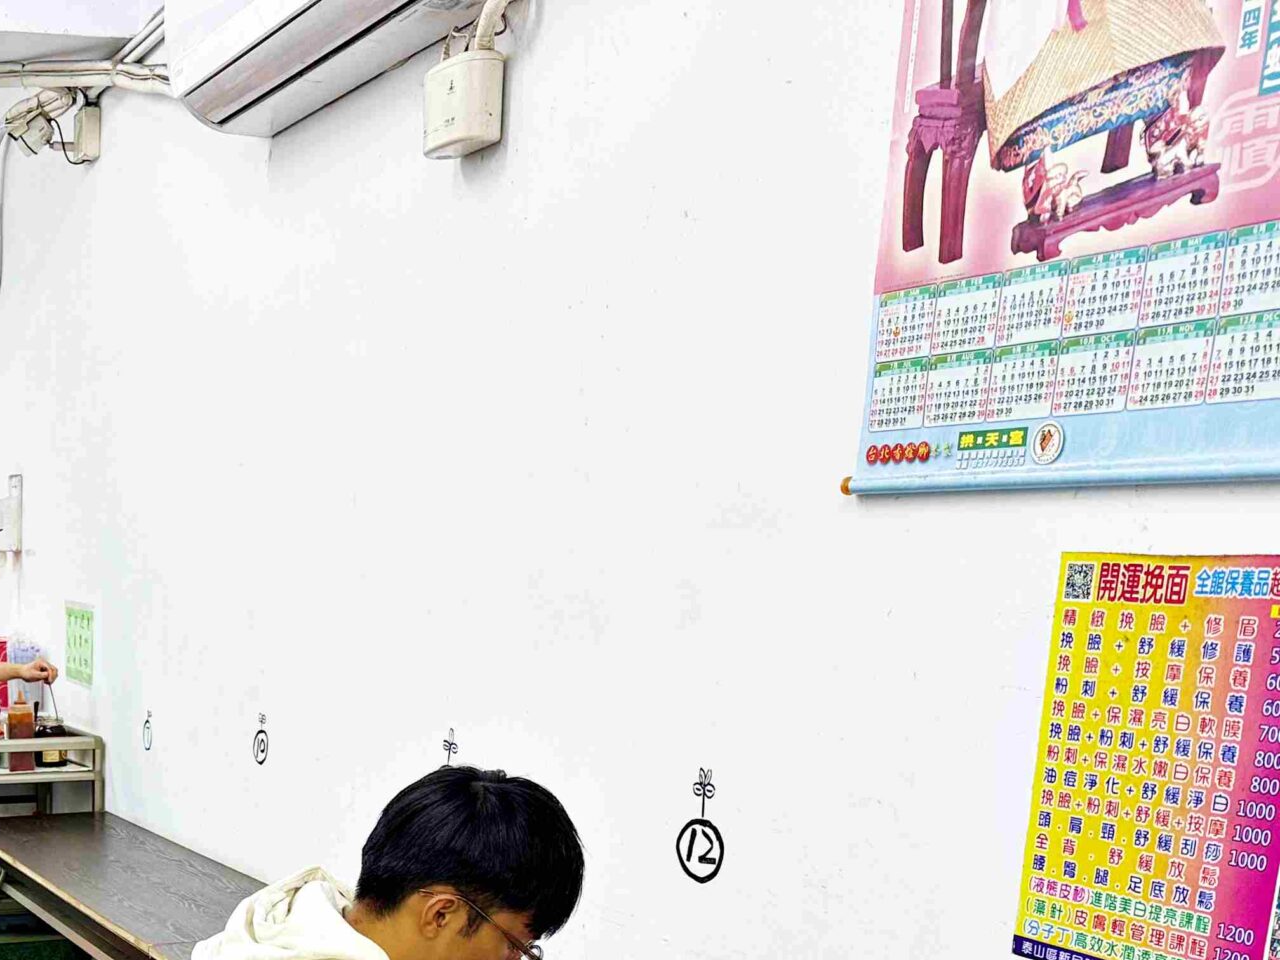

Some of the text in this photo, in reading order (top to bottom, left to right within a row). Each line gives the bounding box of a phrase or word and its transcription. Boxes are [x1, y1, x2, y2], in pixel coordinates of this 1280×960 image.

[1251, 257, 1261, 265] 10
[1263, 255, 1273, 263] 11
[1249, 271, 1259, 279] 17
[1235, 286, 1244, 294] 23
[1088, 297, 1096, 305] 15
[1099, 295, 1107, 303] 16
[1121, 292, 1129, 300] 18
[1154, 299, 1162, 307] 19
[1164, 297, 1173, 305] 20
[1197, 292, 1207, 300] 23
[1233, 300, 1243, 308] 30
[1075, 310, 1084, 318] 21
[1086, 308, 1095, 316] 22
[1107, 305, 1117, 313] 24
[1118, 303, 1128, 311] 25
[1263, 312, 1279, 320] DEC
[1073, 319, 1104, 330] 28 29 30
[1179, 323, 1194, 331] NOV
[1250, 346, 1260, 354] 10
[1224, 361, 1233, 369] 15
[1236, 360, 1245, 368] 16
[1248, 359, 1258, 367] 17
[1099, 375, 1107, 383] 16
[1161, 393, 1171, 401] 26
[1184, 391, 1193, 399] 28
[1194, 390, 1204, 398] 29
[1208, 389, 1217, 397] 28
[1220, 388, 1230, 396] 29
[1084, 400, 1093, 408] 29
[1105, 398, 1114, 406] 31
[1097, 563, 1190, 604] 開運挽面
[1250, 777, 1279, 795] 800
[1237, 800, 1275, 820] 1000
[1233, 825, 1271, 846] 1000
[1229, 850, 1267, 871] 1000
[1218, 924, 1254, 945] 1200
